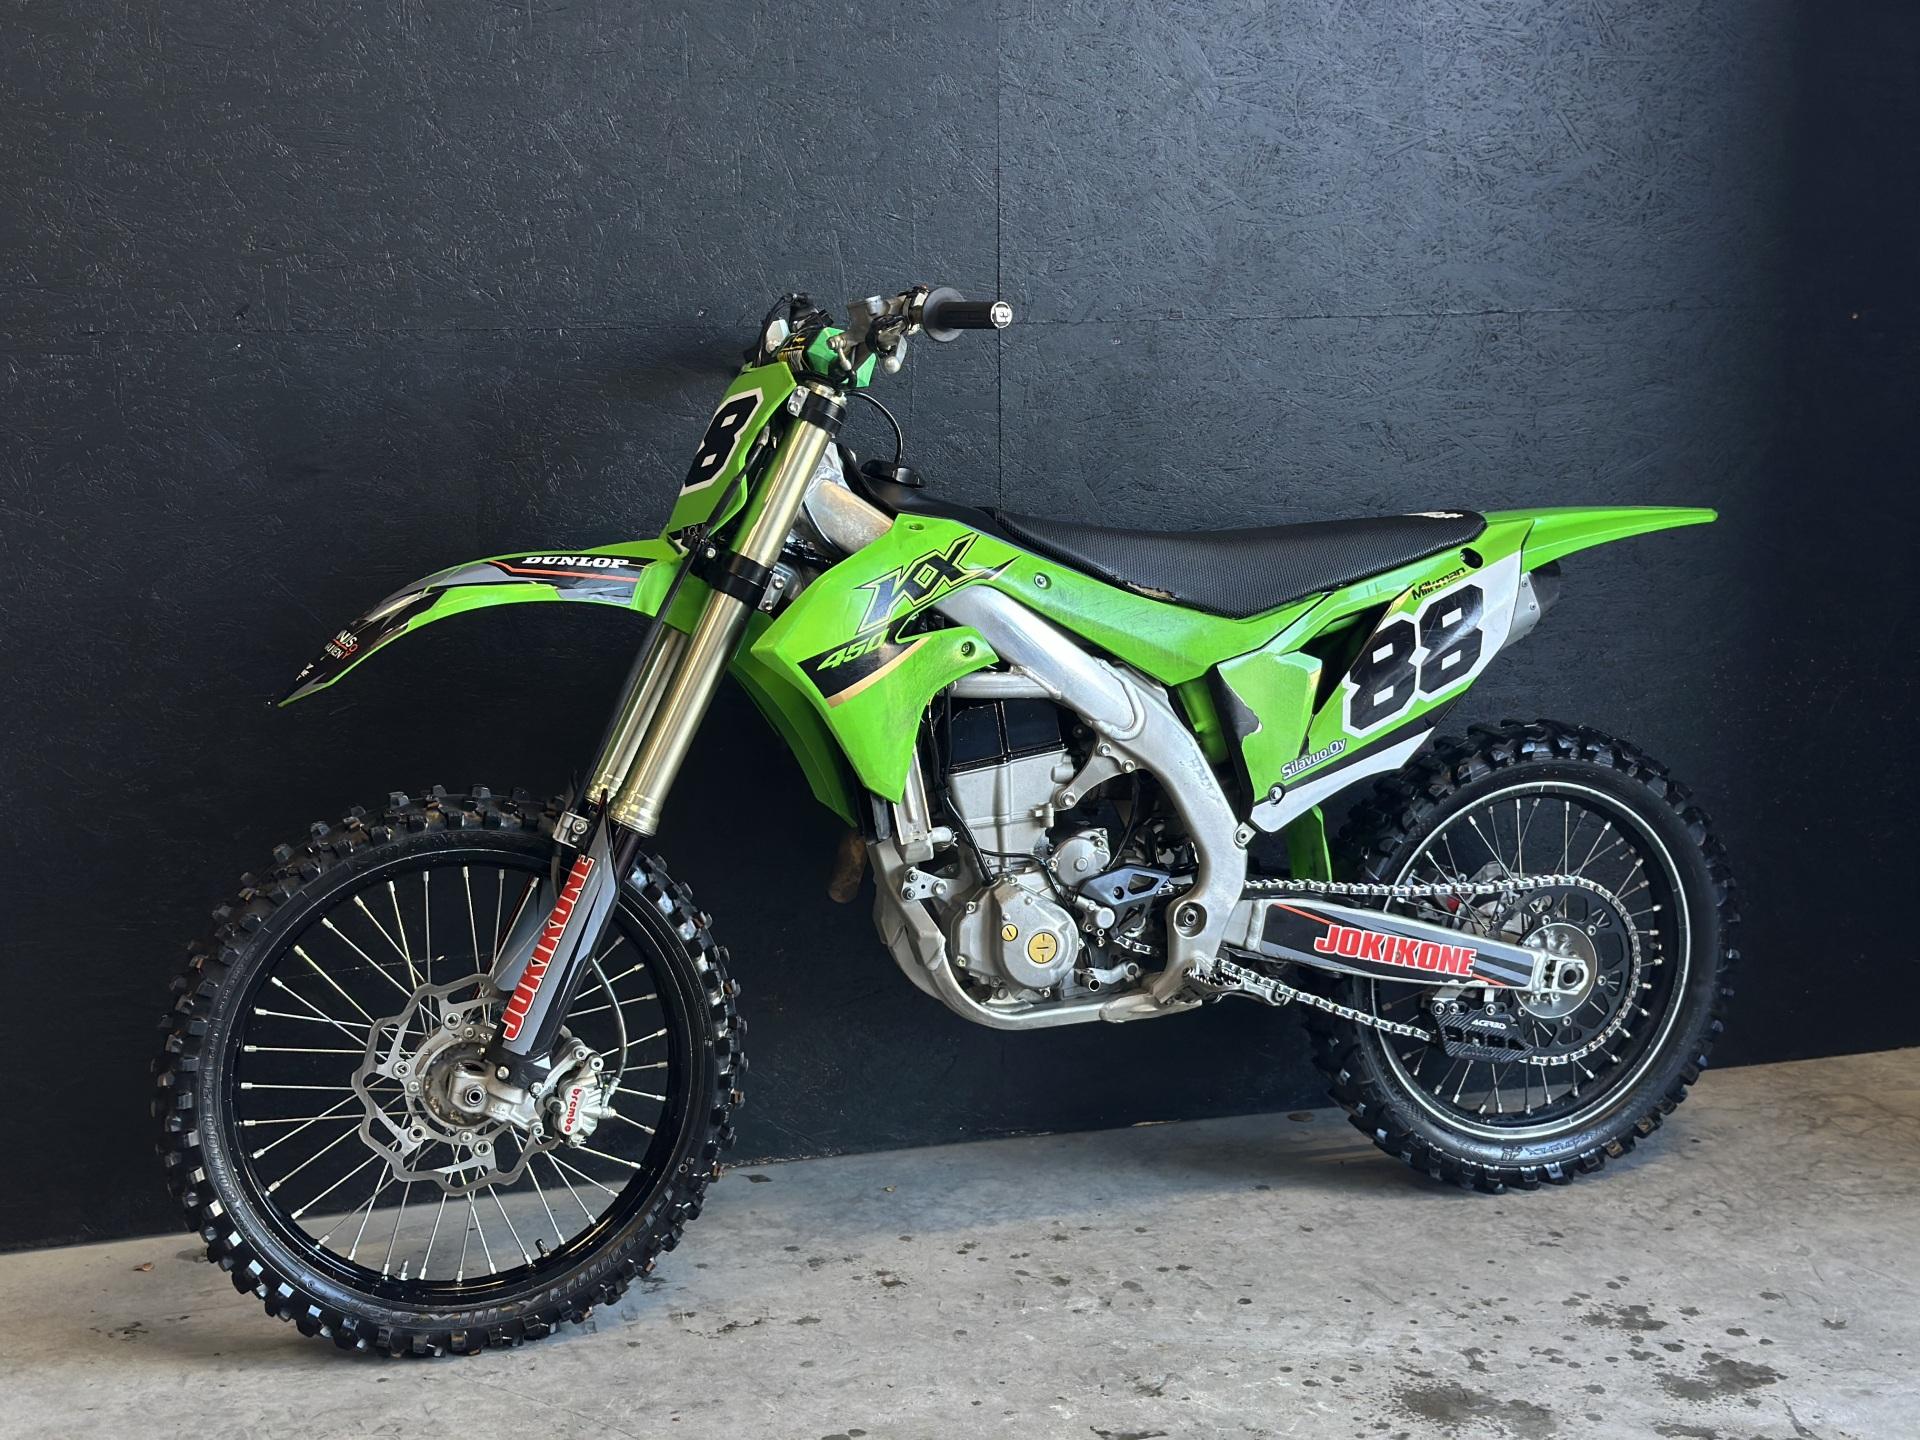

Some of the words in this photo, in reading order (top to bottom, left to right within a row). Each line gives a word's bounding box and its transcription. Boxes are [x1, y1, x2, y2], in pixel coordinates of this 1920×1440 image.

[683, 392, 761, 490] 8
[521, 555, 630, 569] DUNLOP
[853, 532, 994, 635] KX
[816, 628, 890, 671] 450
[1346, 582, 1485, 734] 88
[1281, 749, 1328, 779] Silavuo
[501, 853, 595, 1041] JOKIKONE
[1314, 923, 1478, 977] JOKIKONE
[564, 1088, 582, 1132] brembo
